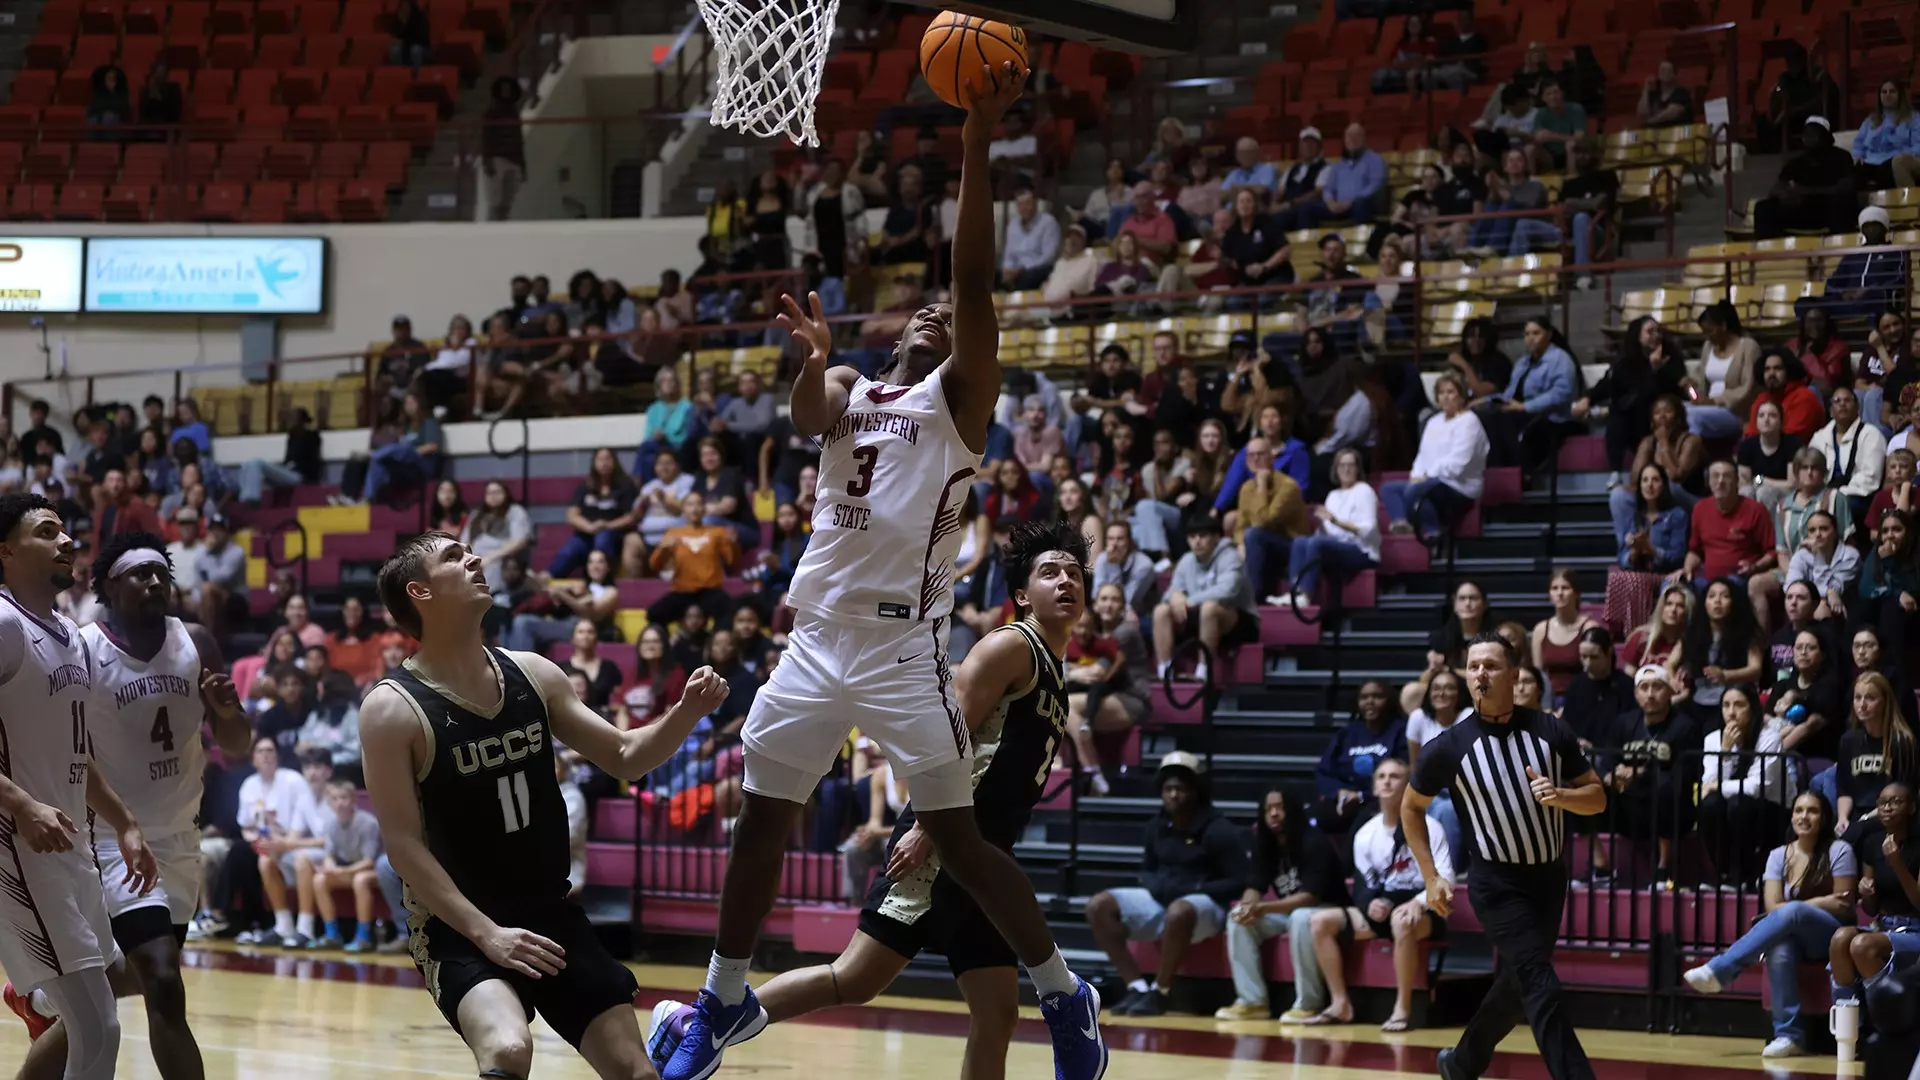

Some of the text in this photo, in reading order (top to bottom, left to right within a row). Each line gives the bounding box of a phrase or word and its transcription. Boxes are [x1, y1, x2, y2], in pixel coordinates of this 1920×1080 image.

[827, 412, 921, 447] MIDWESTERN
[846, 445, 879, 498] 3
[832, 504, 871, 531] STATE
[114, 674, 190, 710] MIDWESTERN
[150, 705, 174, 752] 4
[451, 721, 543, 775] UCCS
[149, 757, 180, 780] STATE
[496, 770, 531, 834] 11
